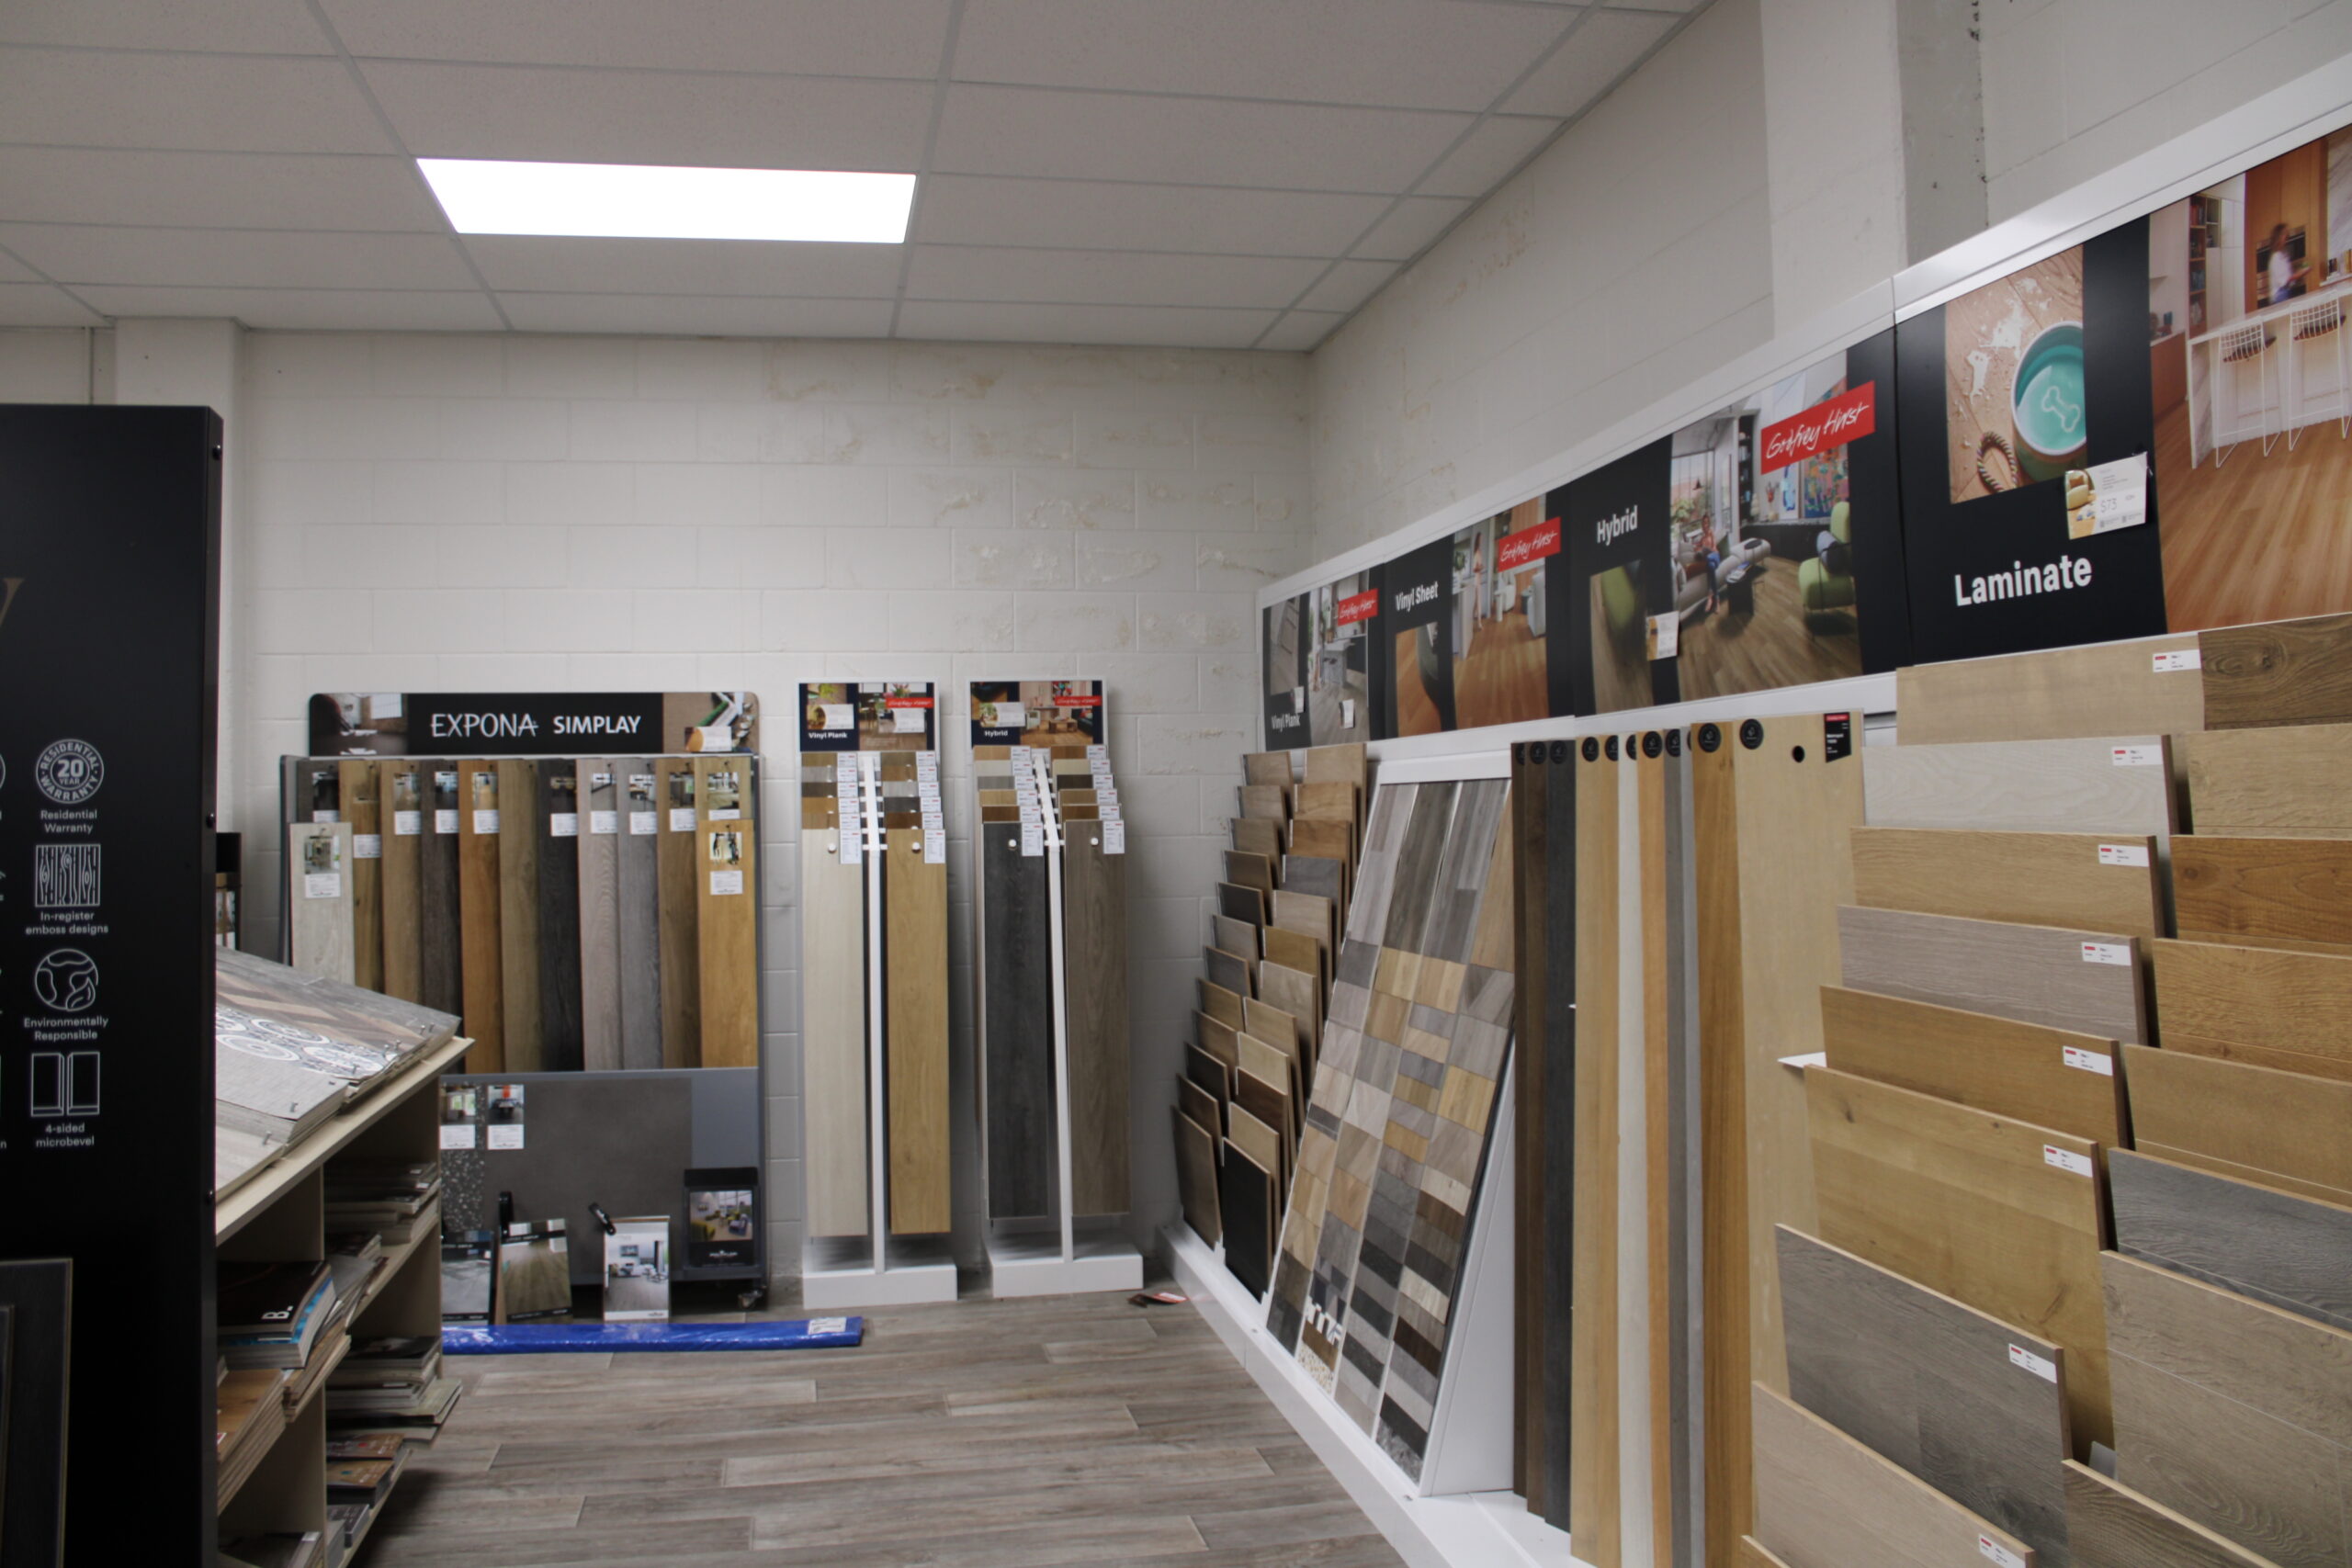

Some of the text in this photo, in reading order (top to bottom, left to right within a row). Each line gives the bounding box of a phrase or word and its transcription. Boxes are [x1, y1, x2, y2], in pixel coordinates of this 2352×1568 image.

[1766, 402, 1871, 460] Godfrey Hirst
[1597, 505, 1638, 547] Hybrid
[1954, 555, 2093, 606] Laminate
[1396, 581, 1439, 613] Vinyl Sheet
[430, 713, 641, 738] EXPONA SIMPLAY
[1271, 712, 1301, 733] Vinyl Plank
[808, 731, 827, 740] Vinyl
[984, 729, 1009, 738] Hybrid
[40, 742, 99, 770] RESIDENTIAL
[57, 759, 85, 778] 20
[40, 775, 98, 800] WARRANTY
[40, 809, 97, 820] Residential
[44, 823, 94, 834] Warranty
[40, 911, 95, 922] In-register
[25, 923, 109, 935] emboss designs
[24, 1015, 108, 1028] Environmentally
[34, 1030, 98, 1042] Responsible
[45, 1122, 85, 1134] 4-sided
[36, 1135, 95, 1147] microbevel
